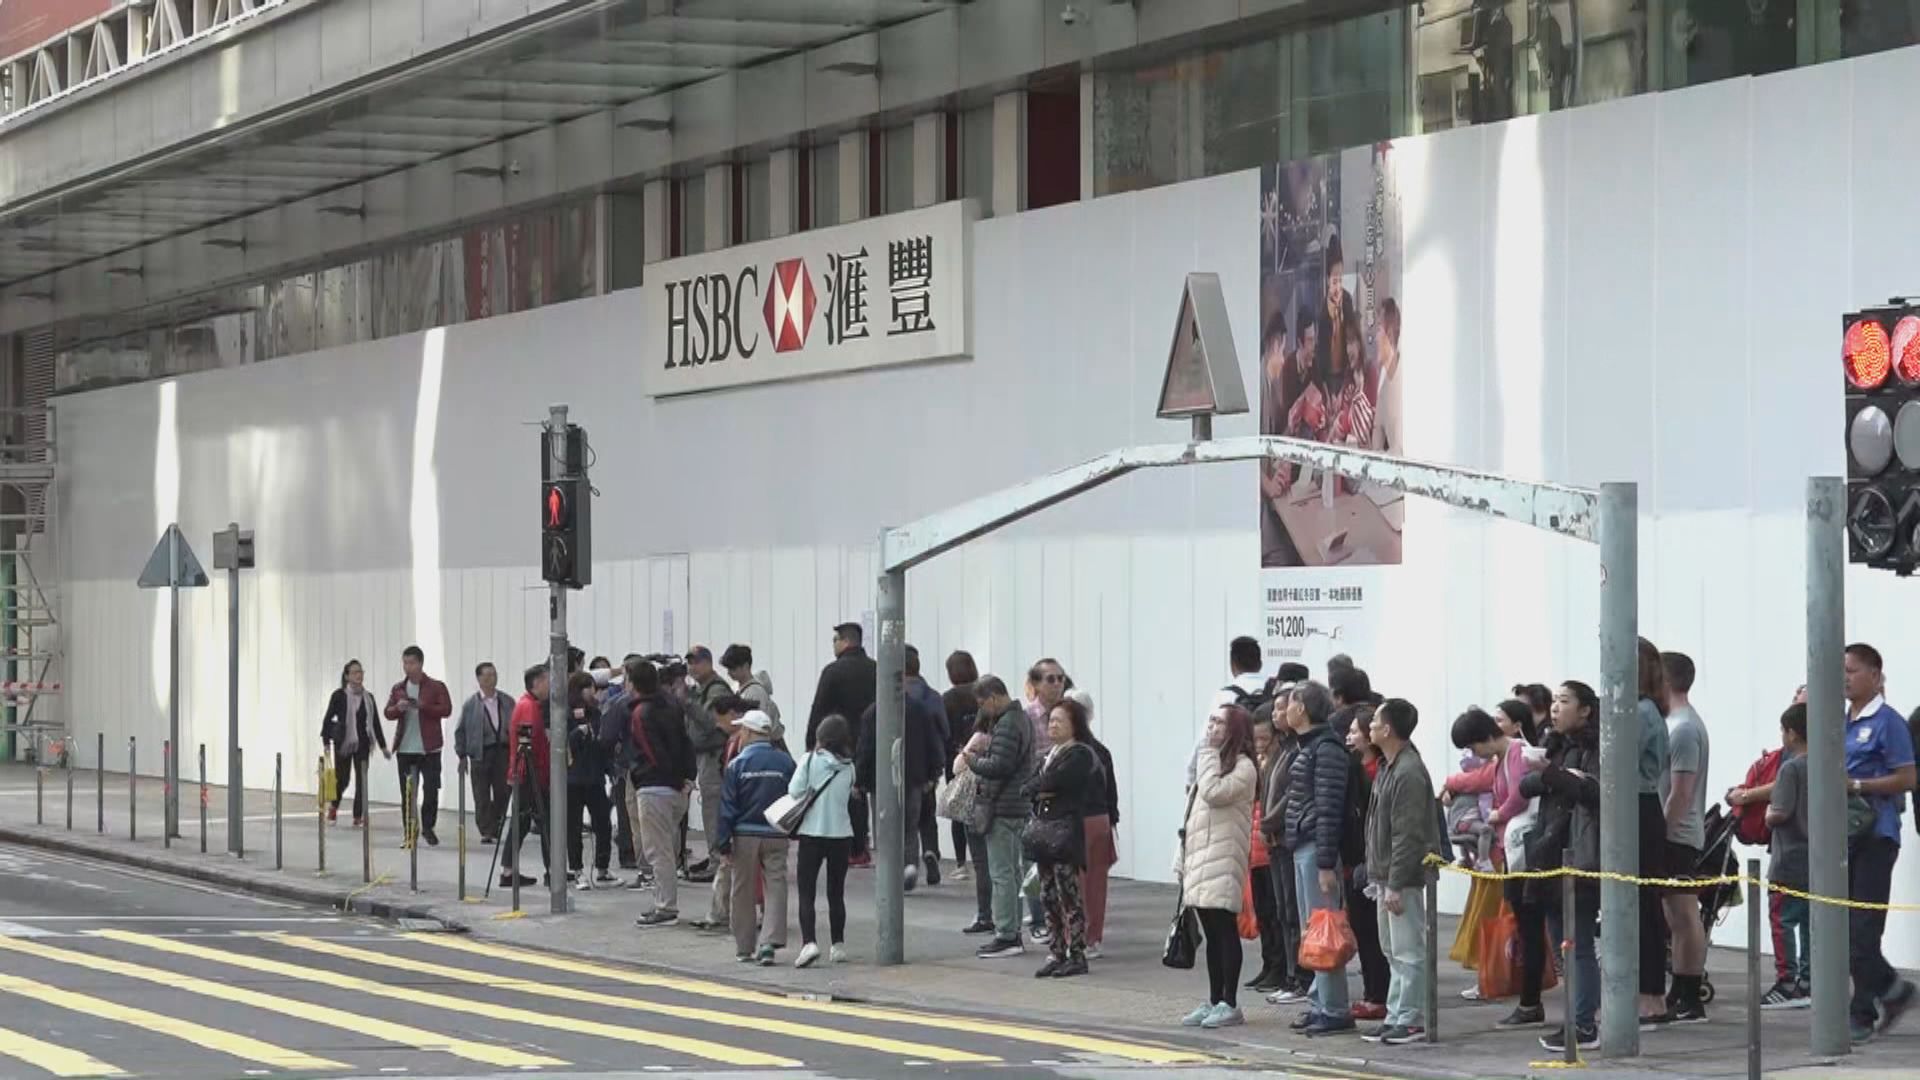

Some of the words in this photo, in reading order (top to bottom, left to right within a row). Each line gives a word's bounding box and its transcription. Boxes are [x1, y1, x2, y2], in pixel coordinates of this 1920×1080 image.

[664, 265, 759, 369] HSBC
[823, 235, 936, 345] 滙豐
[1275, 616, 1305, 640] $1,200
